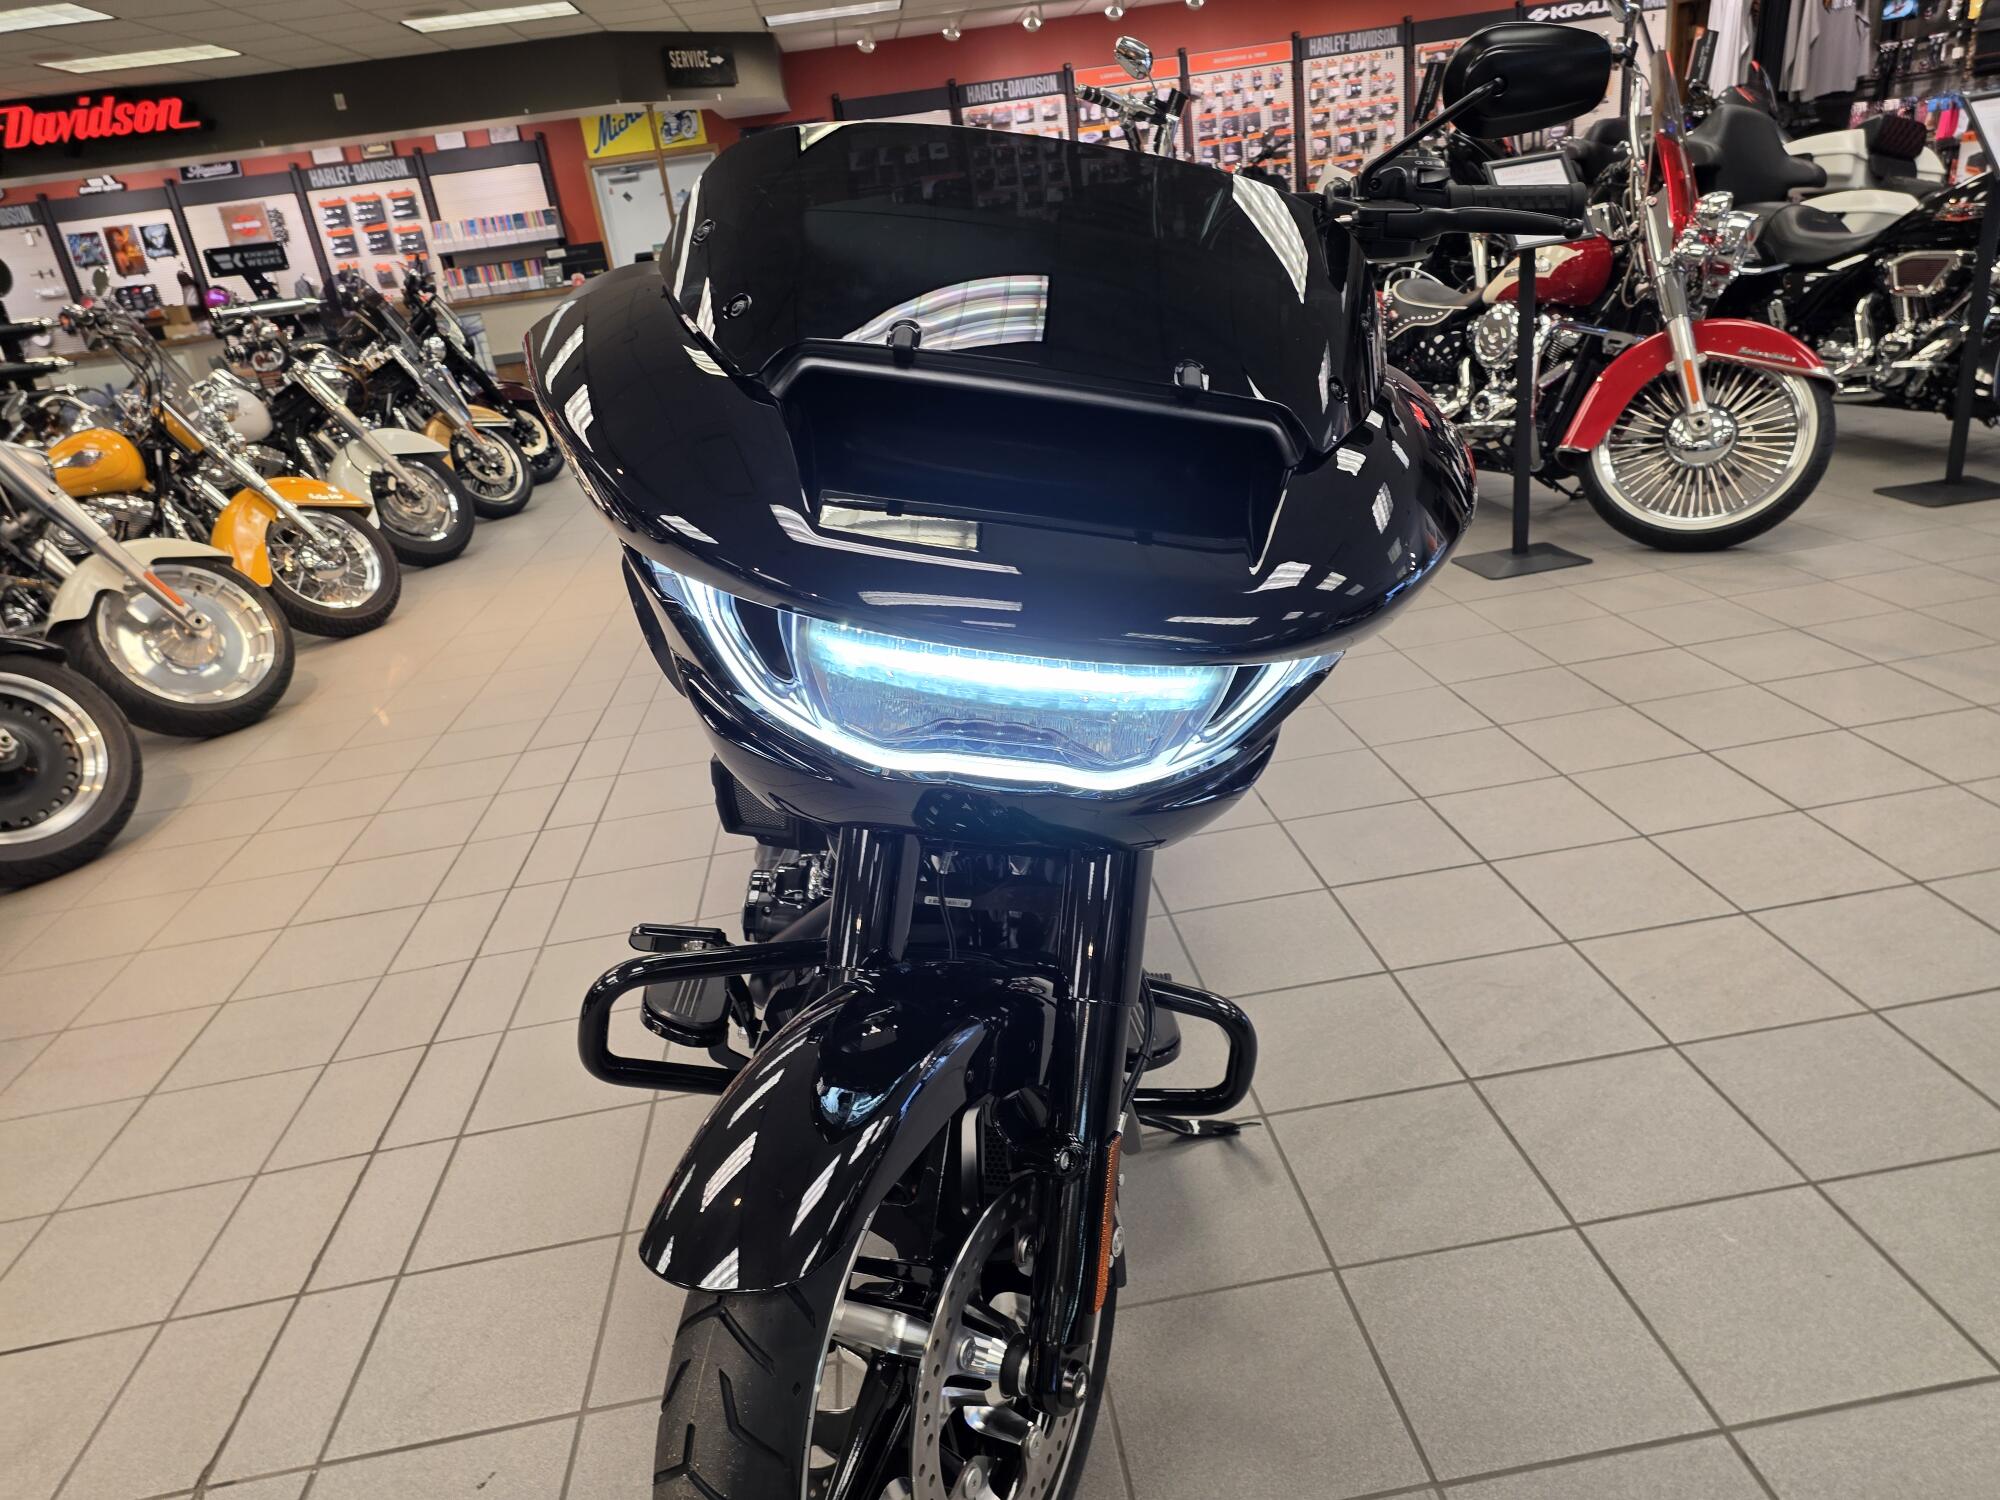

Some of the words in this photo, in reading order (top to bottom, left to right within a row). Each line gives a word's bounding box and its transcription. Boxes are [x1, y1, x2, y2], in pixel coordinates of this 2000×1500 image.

[1549, 0, 1611, 19] KRAU
[1309, 26, 1399, 56] HARLEY-DAVIDSON
[669, 50, 712, 69] SERVICE
[966, 74, 1059, 103] HARLEY-DAVIDSON
[308, 158, 410, 188] HARLEY-DAVIDSON
